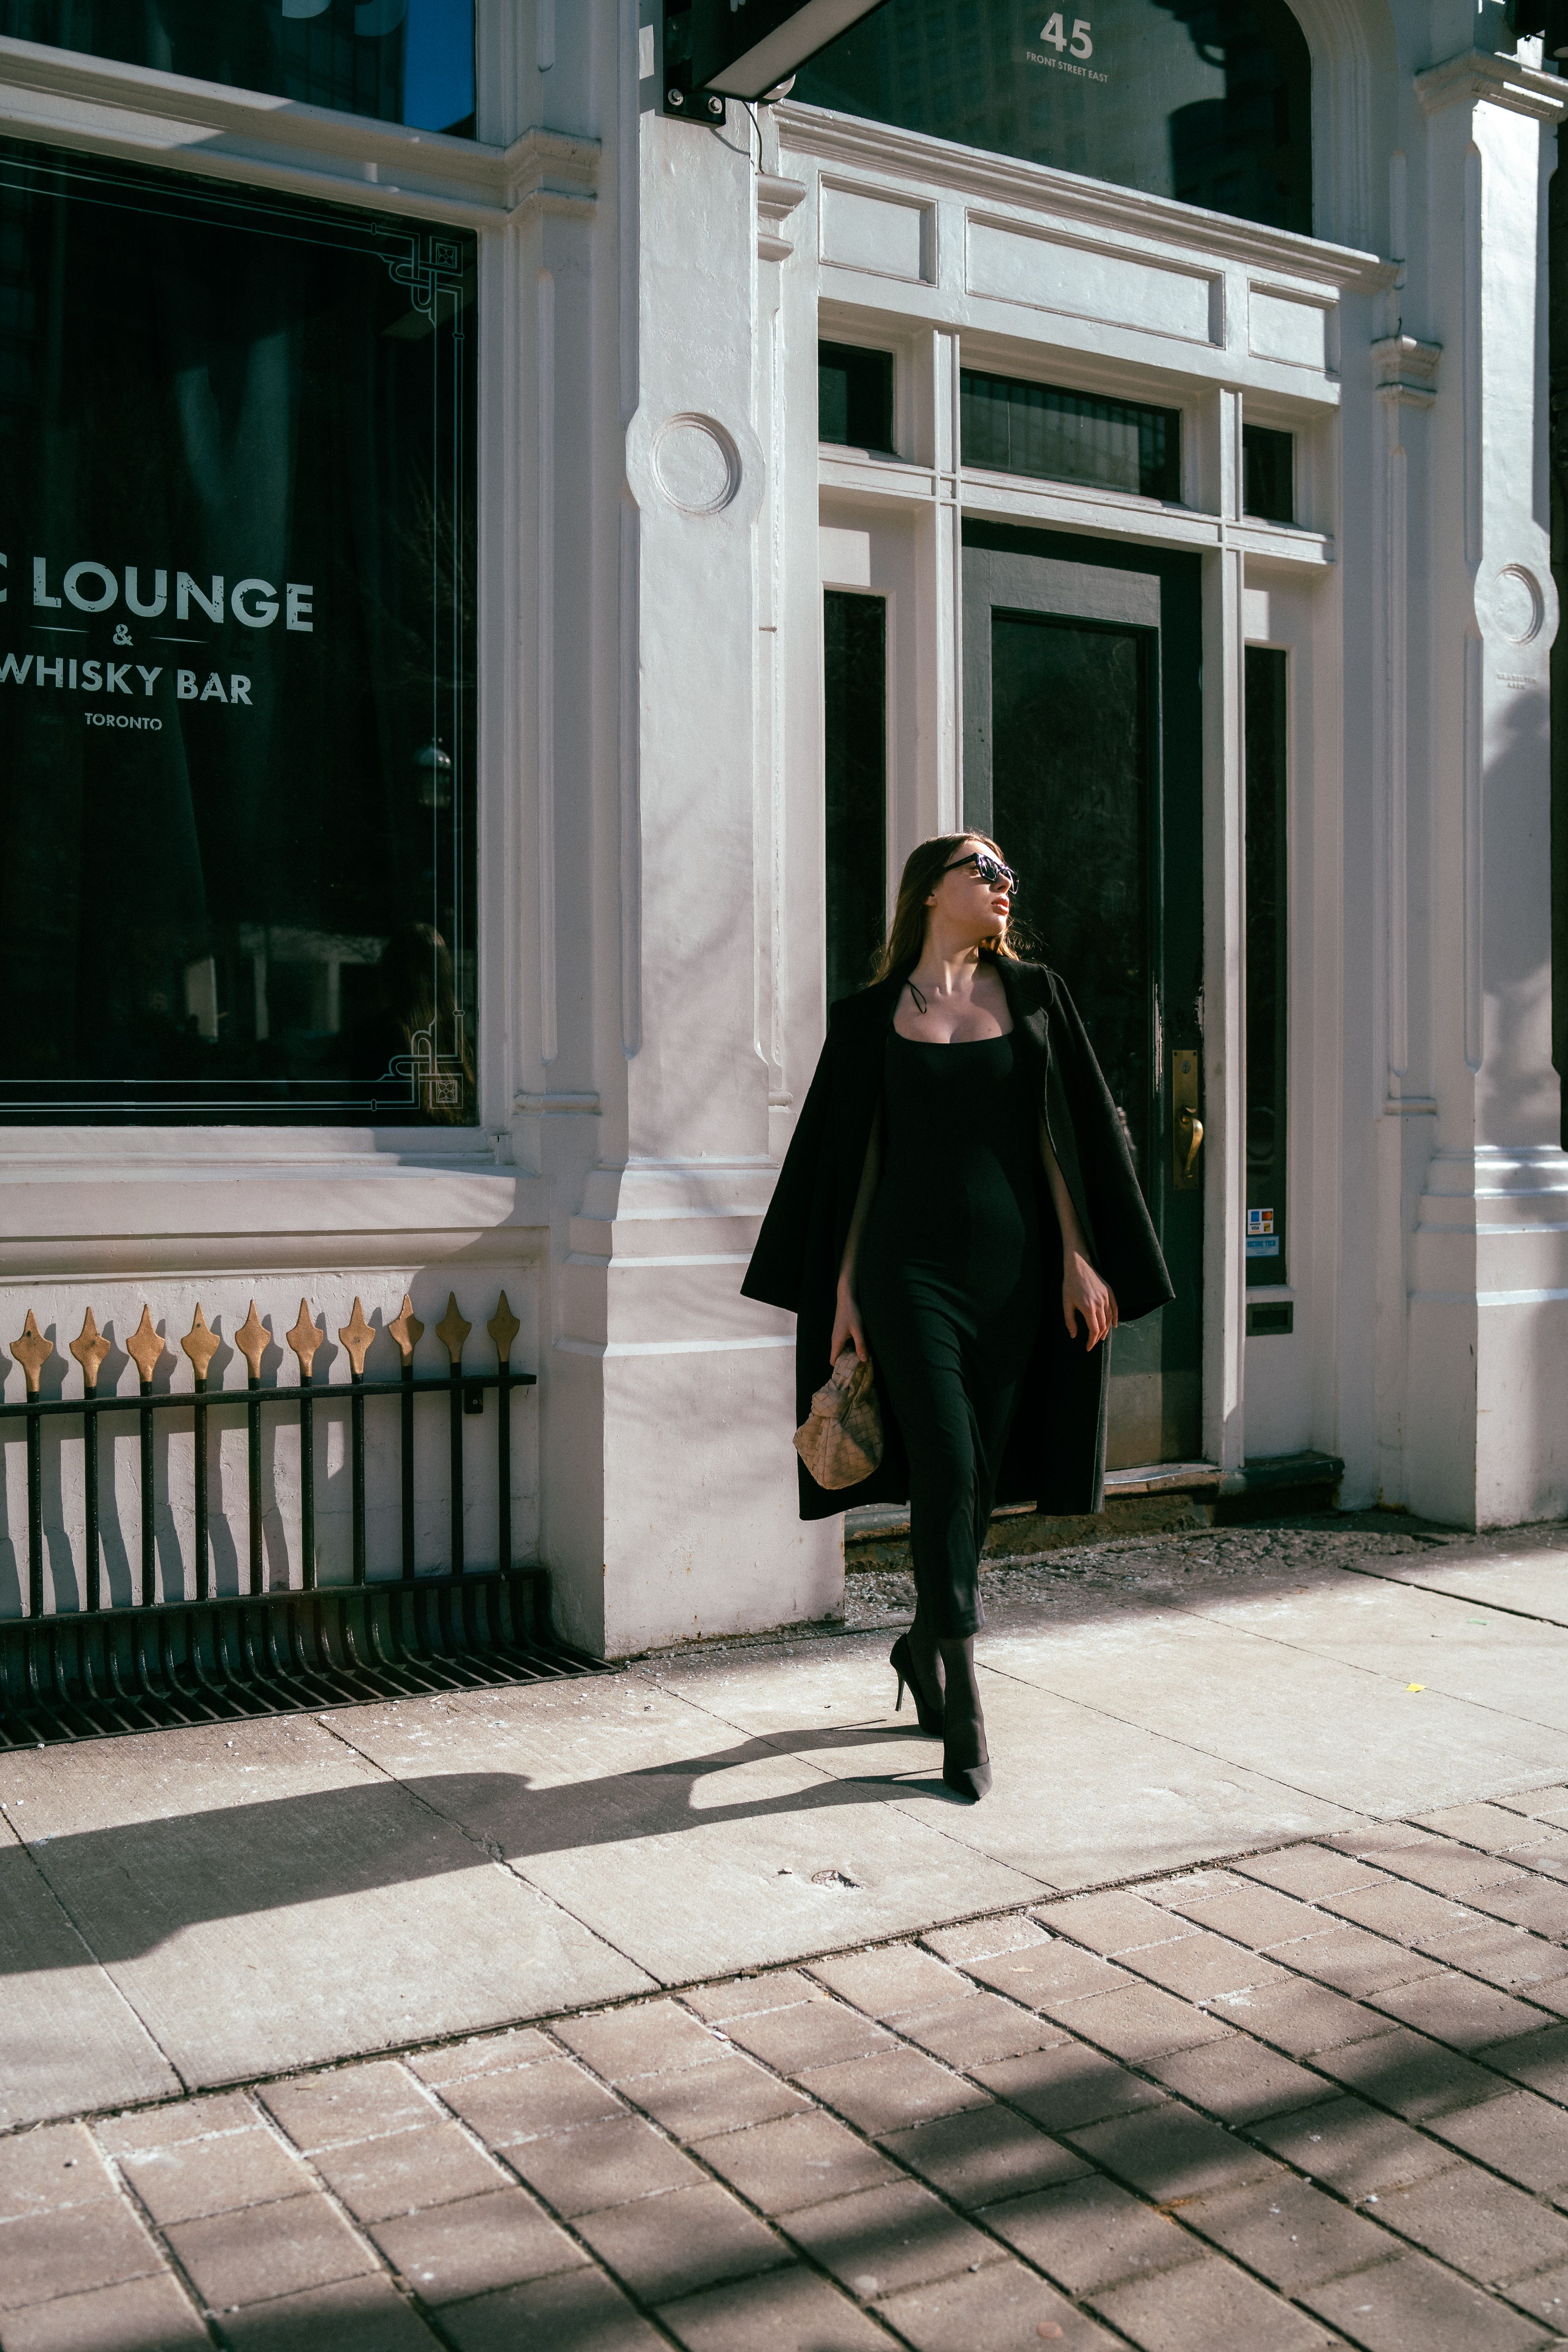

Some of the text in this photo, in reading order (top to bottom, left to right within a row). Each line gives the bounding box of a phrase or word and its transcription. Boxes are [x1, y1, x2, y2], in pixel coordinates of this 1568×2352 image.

[1040, 12, 1093, 59] 45
[1026, 51, 1108, 82] FRONT STREET EAST
[33, 557, 313, 632] LOUNGE
[113, 624, 134, 646] &
[0, 653, 253, 705] WHISKY BAR
[84, 713, 162, 730] TORONTO
